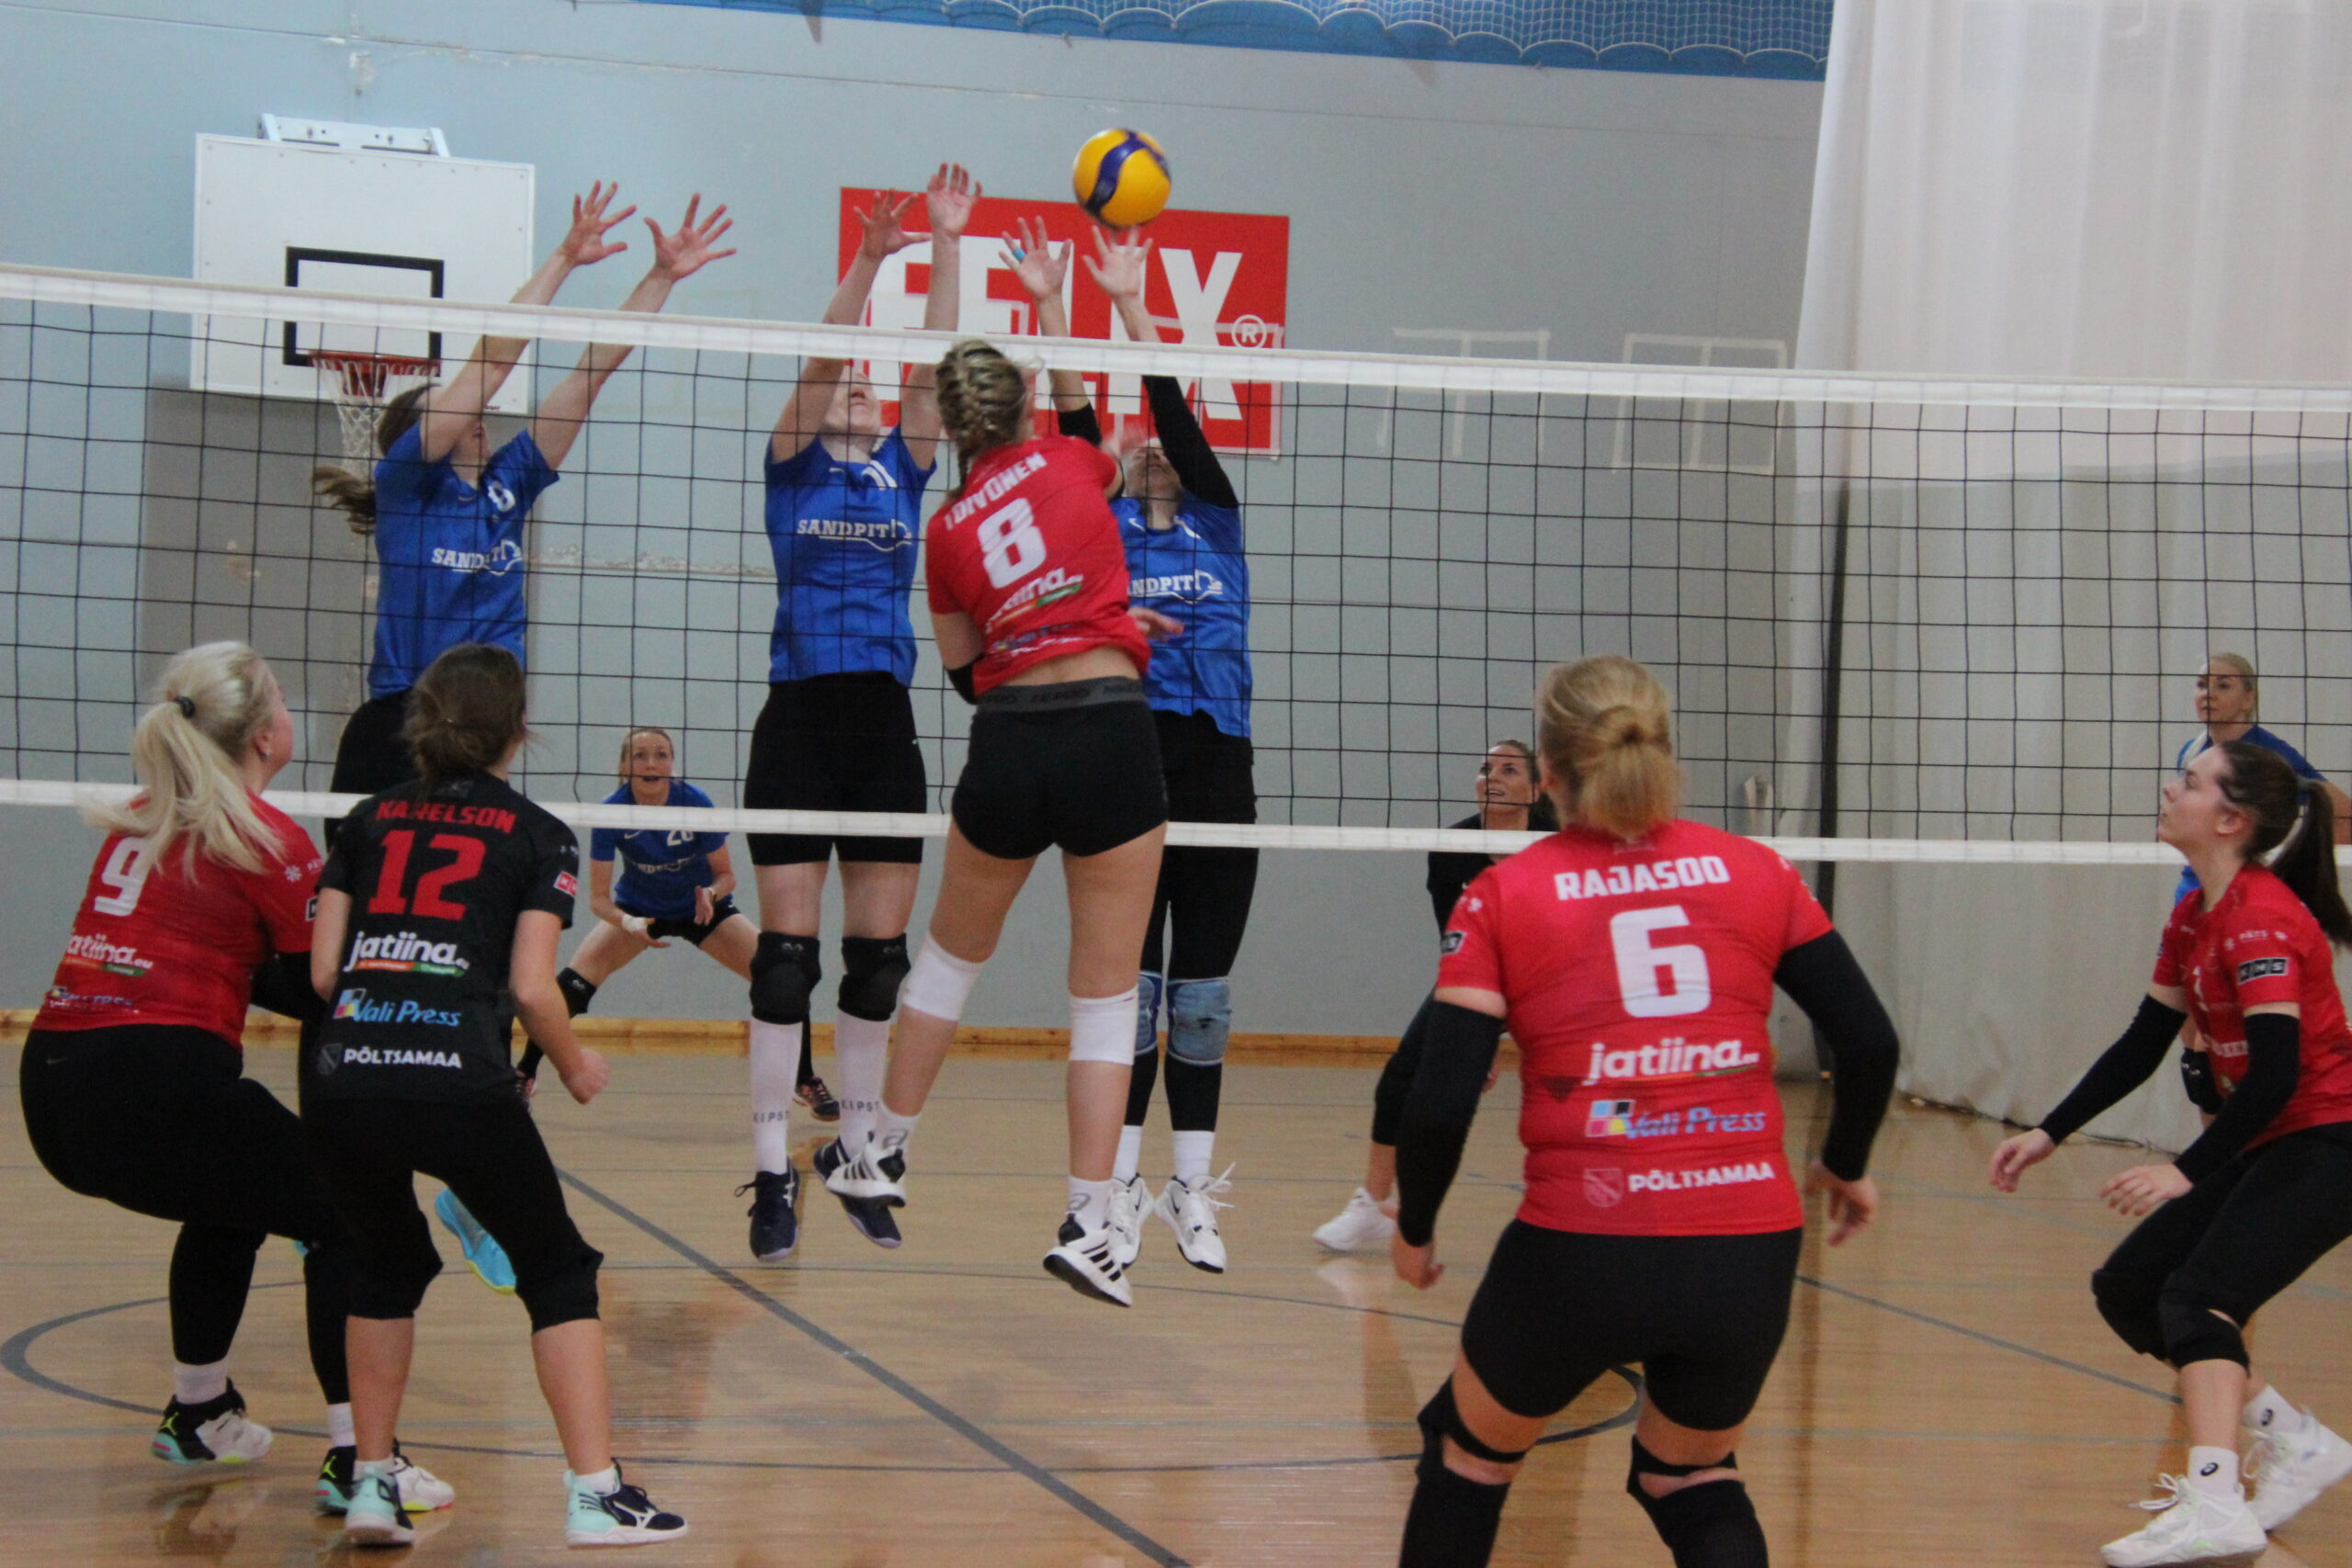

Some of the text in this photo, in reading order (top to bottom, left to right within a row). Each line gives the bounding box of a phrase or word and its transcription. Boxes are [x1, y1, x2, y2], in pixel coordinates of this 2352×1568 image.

[797, 520, 890, 538] SANDPIT
[977, 497, 1047, 589] 8
[94, 837, 151, 917] 9
[368, 829, 486, 919] 12
[1554, 855, 1731, 901] RAJASOO
[1610, 905, 1712, 1019] 6
[395, 1000, 461, 1027] Press
[1685, 1107, 1768, 1134] Press
